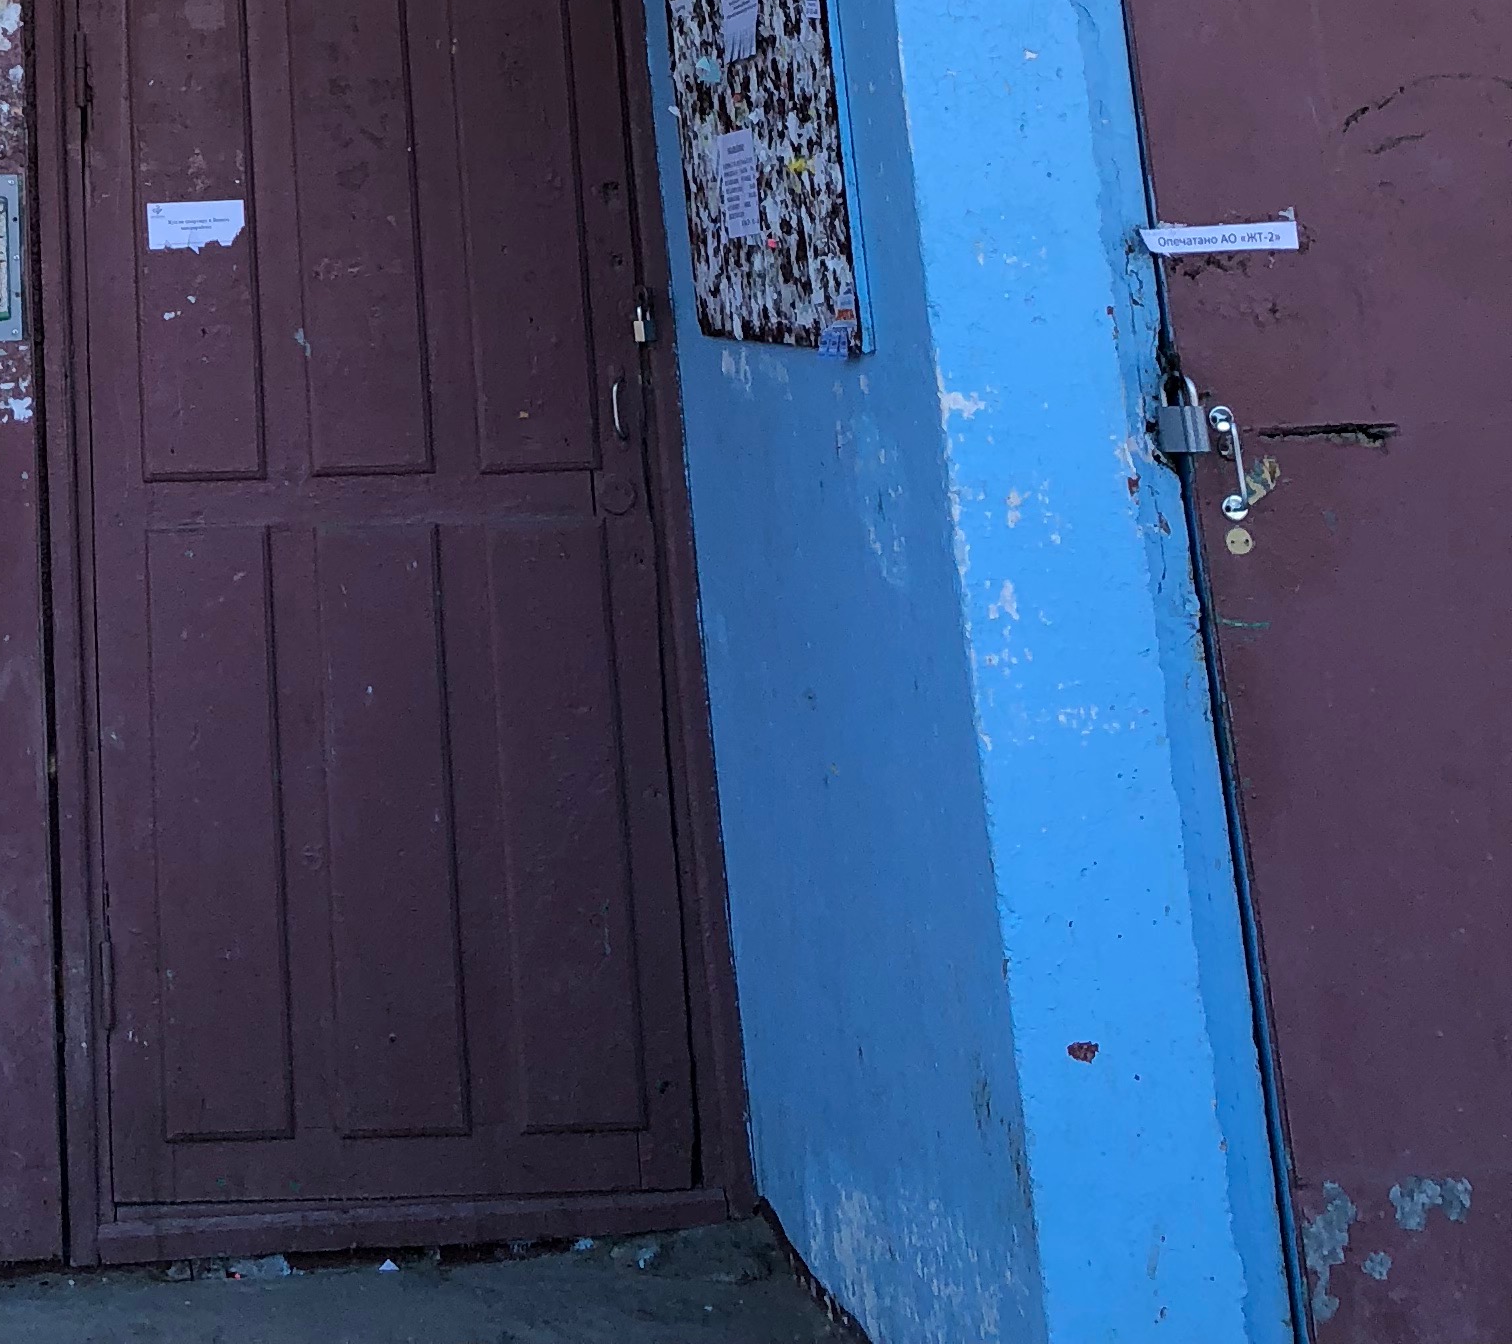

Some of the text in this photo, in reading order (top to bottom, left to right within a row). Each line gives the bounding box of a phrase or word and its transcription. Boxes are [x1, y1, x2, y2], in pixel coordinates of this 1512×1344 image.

[1157, 231, 1281, 248] Опечатано АО «ЖТ-2»
